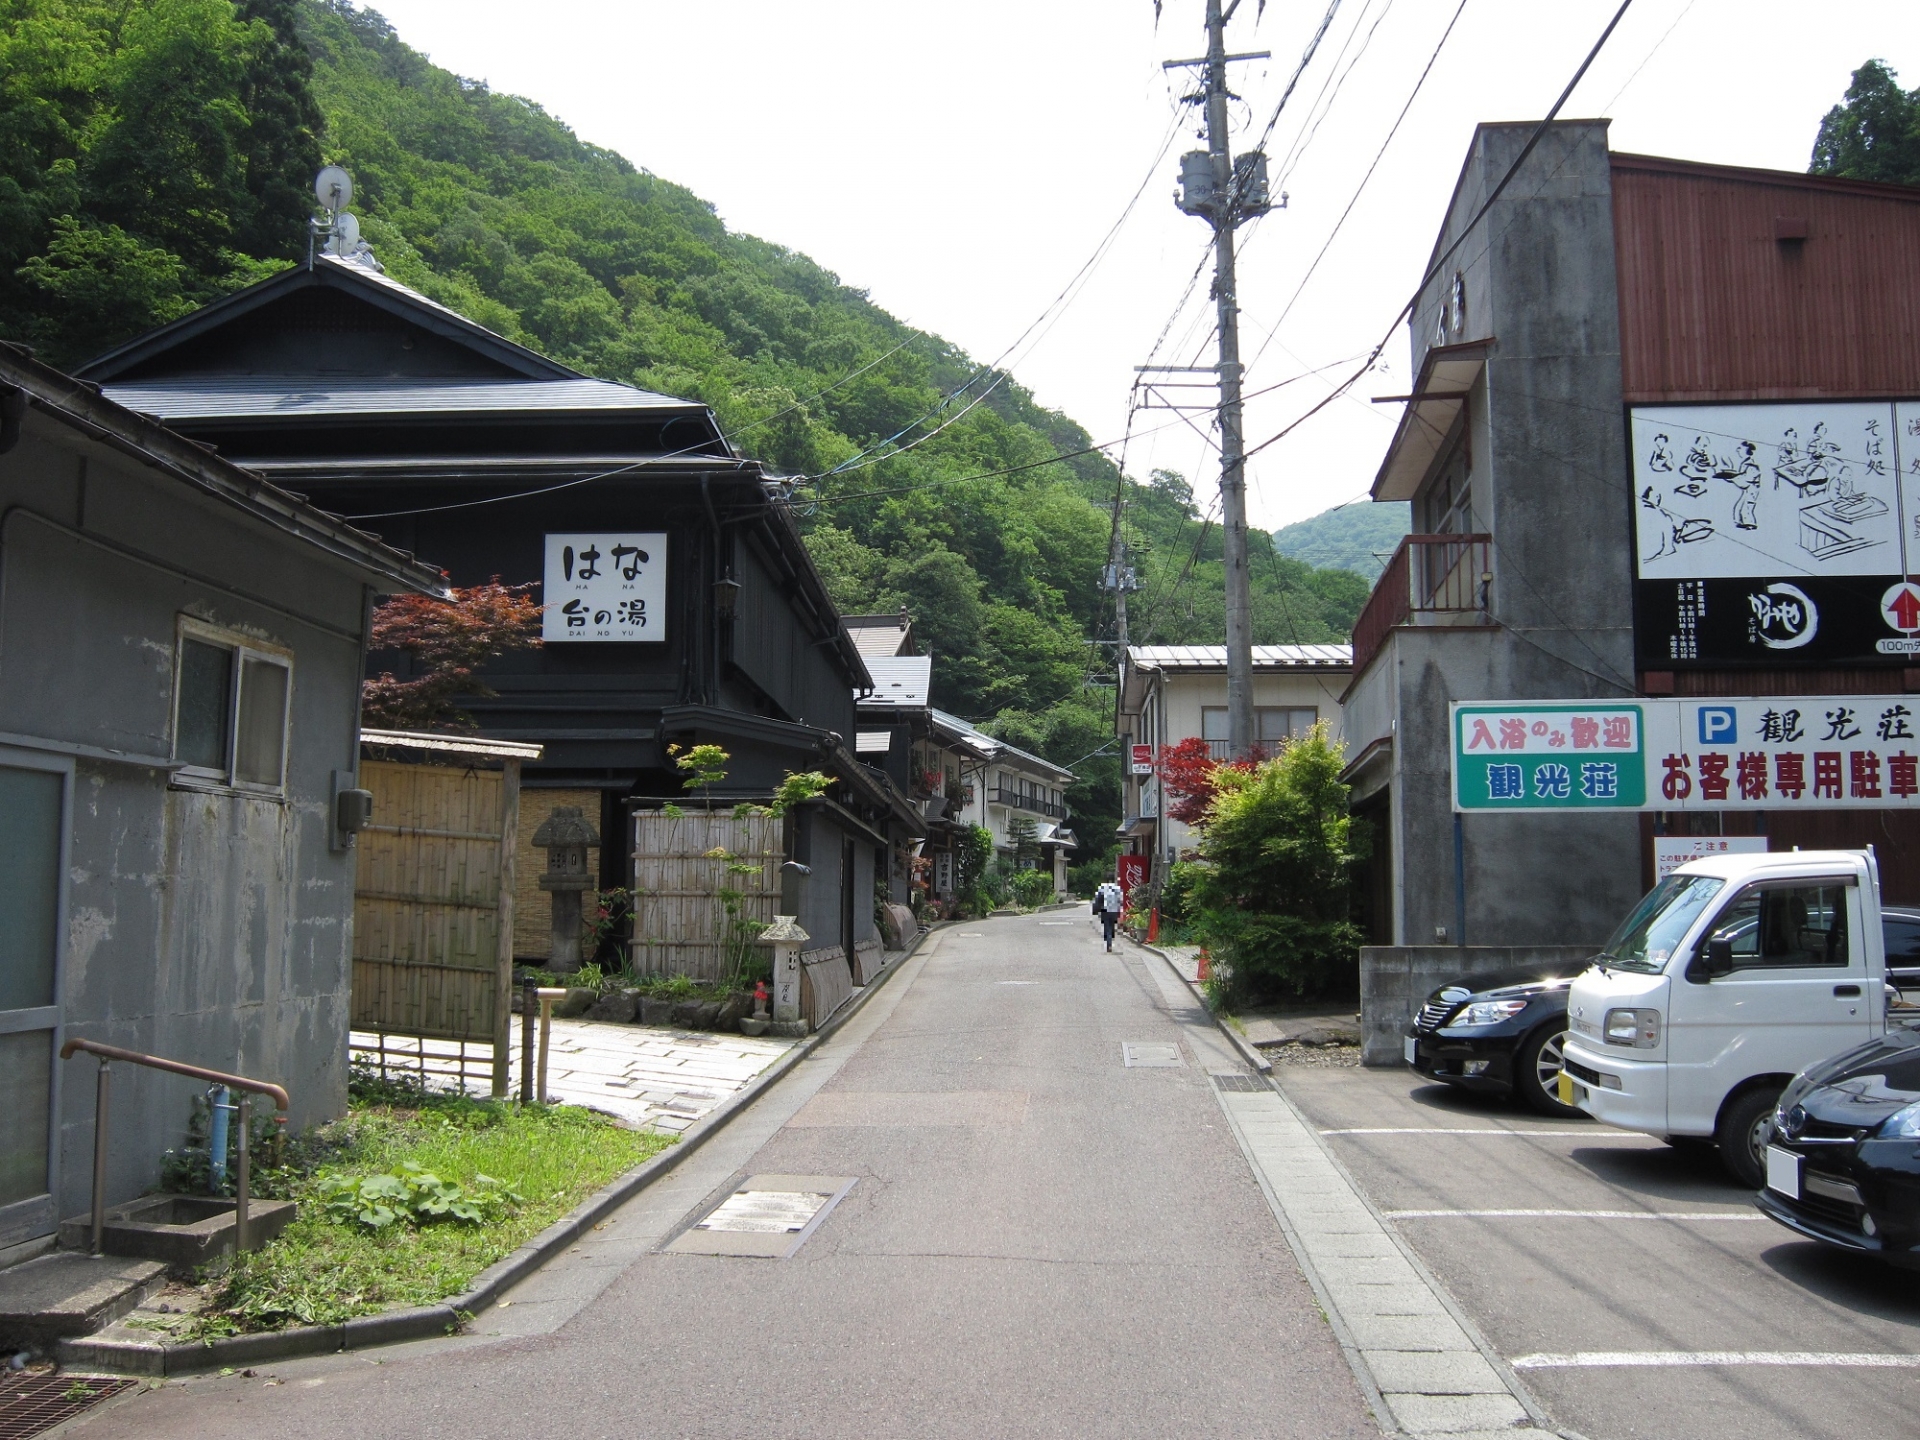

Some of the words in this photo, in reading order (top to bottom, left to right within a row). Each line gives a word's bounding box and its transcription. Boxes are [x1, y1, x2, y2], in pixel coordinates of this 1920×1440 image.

[1864, 418, 1886, 477] そば処
[562, 542, 649, 582] はな
[562, 598, 646, 628] 台の湯
[1467, 716, 1634, 750] 入浴のみ歓迎
[1705, 710, 1732, 741] P
[1755, 704, 1915, 743] 観光荘
[1486, 763, 1619, 800] 観光荘
[1661, 750, 1919, 801] お客様専用駐車
[1660, 854, 1711, 863] この駐車場
[1693, 841, 1729, 851] ご注意
